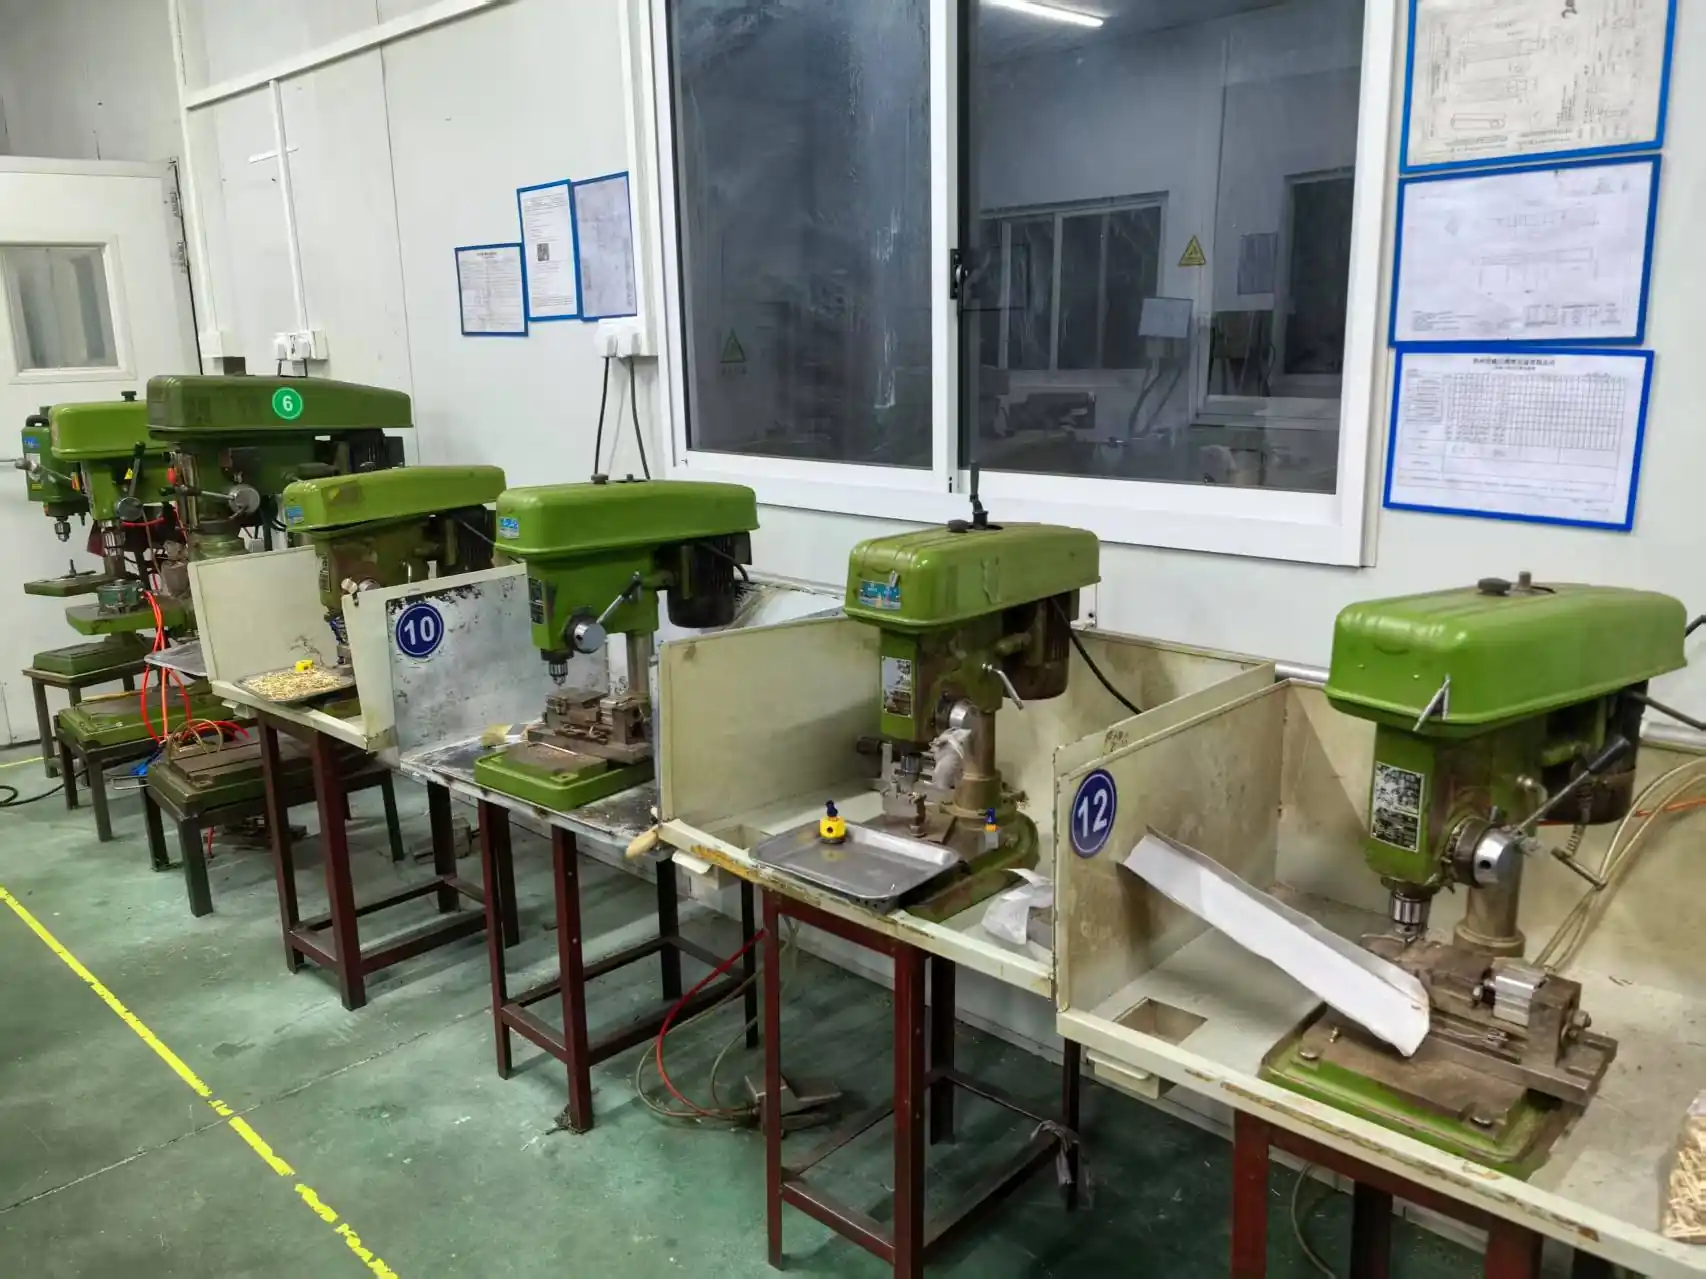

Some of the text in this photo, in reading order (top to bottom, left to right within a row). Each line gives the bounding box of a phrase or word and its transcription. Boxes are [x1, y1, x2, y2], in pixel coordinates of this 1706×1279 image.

[283, 395, 293, 411] 6
[404, 616, 435, 645] 10
[1078, 788, 1108, 838] 12
